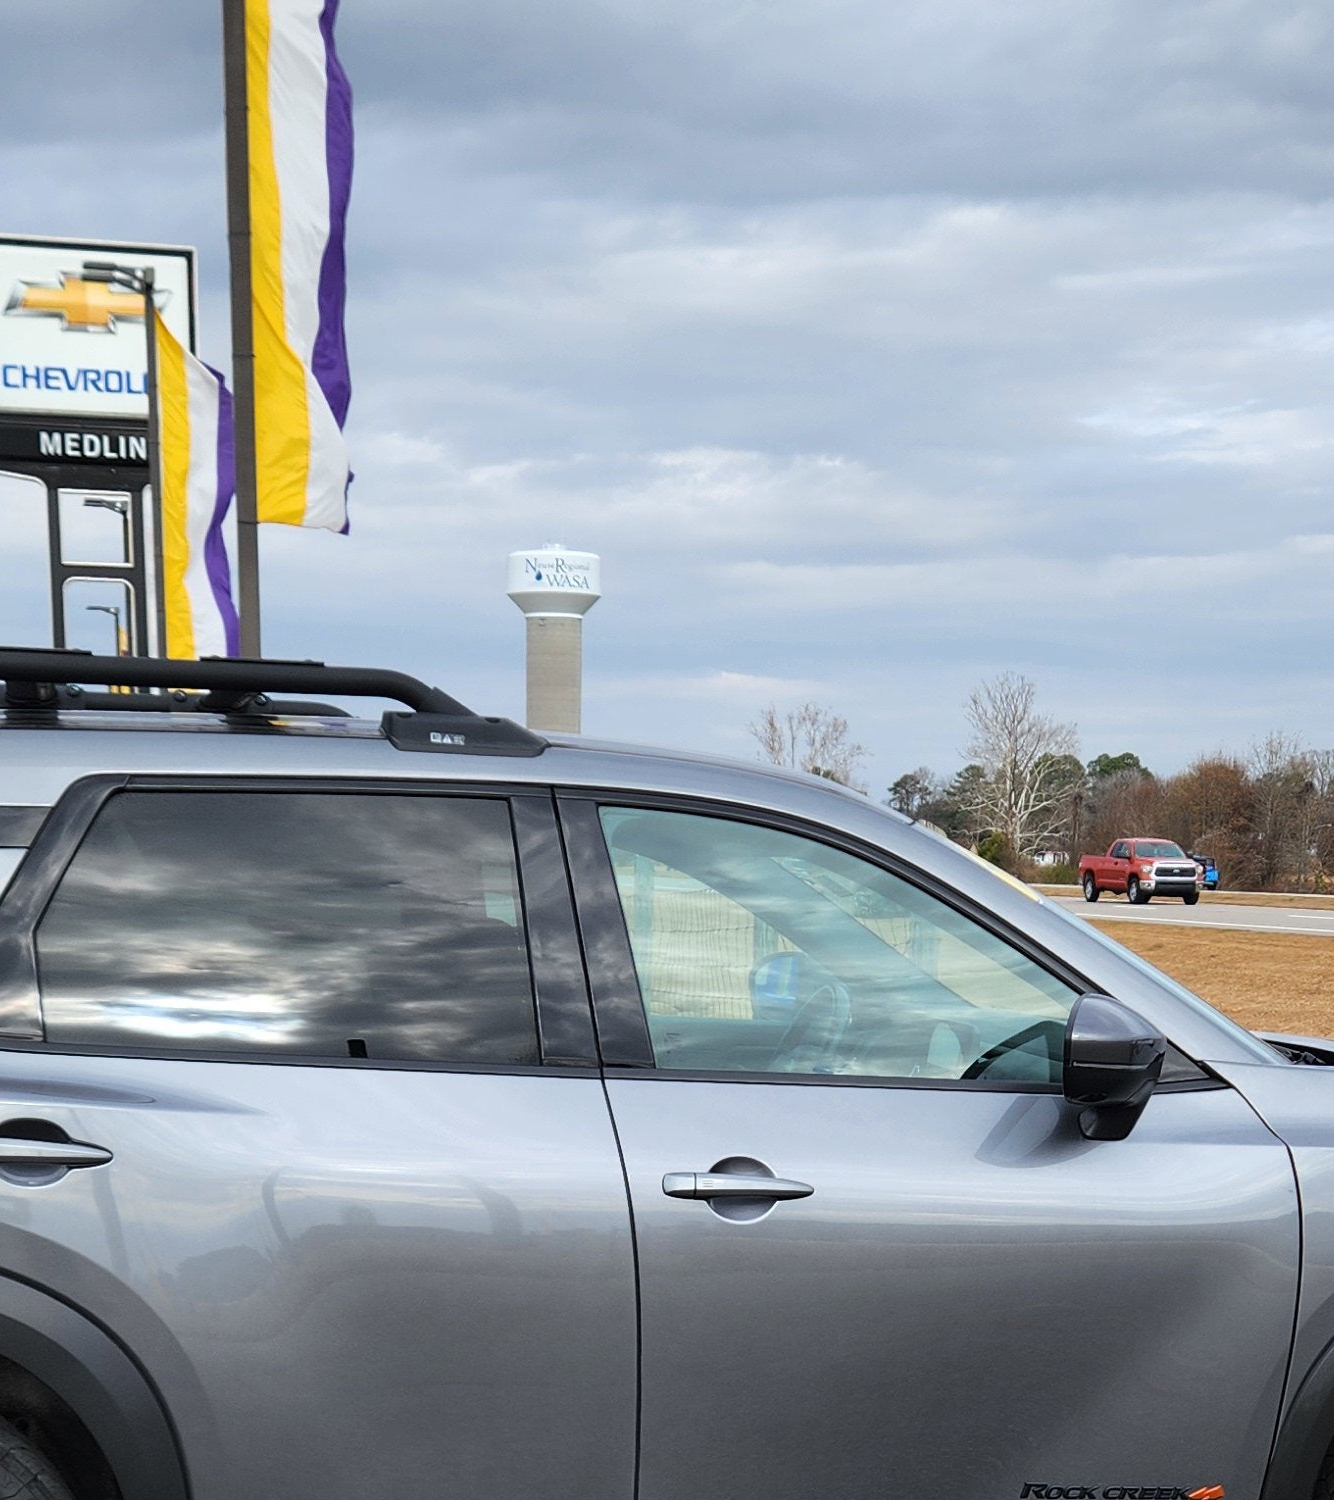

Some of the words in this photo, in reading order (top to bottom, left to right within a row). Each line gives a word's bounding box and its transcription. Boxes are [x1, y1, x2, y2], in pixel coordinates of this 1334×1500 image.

[1, 364, 149, 395] CHEVROL
[39, 431, 148, 460] MEDLIN
[546, 573, 590, 590] WASA
